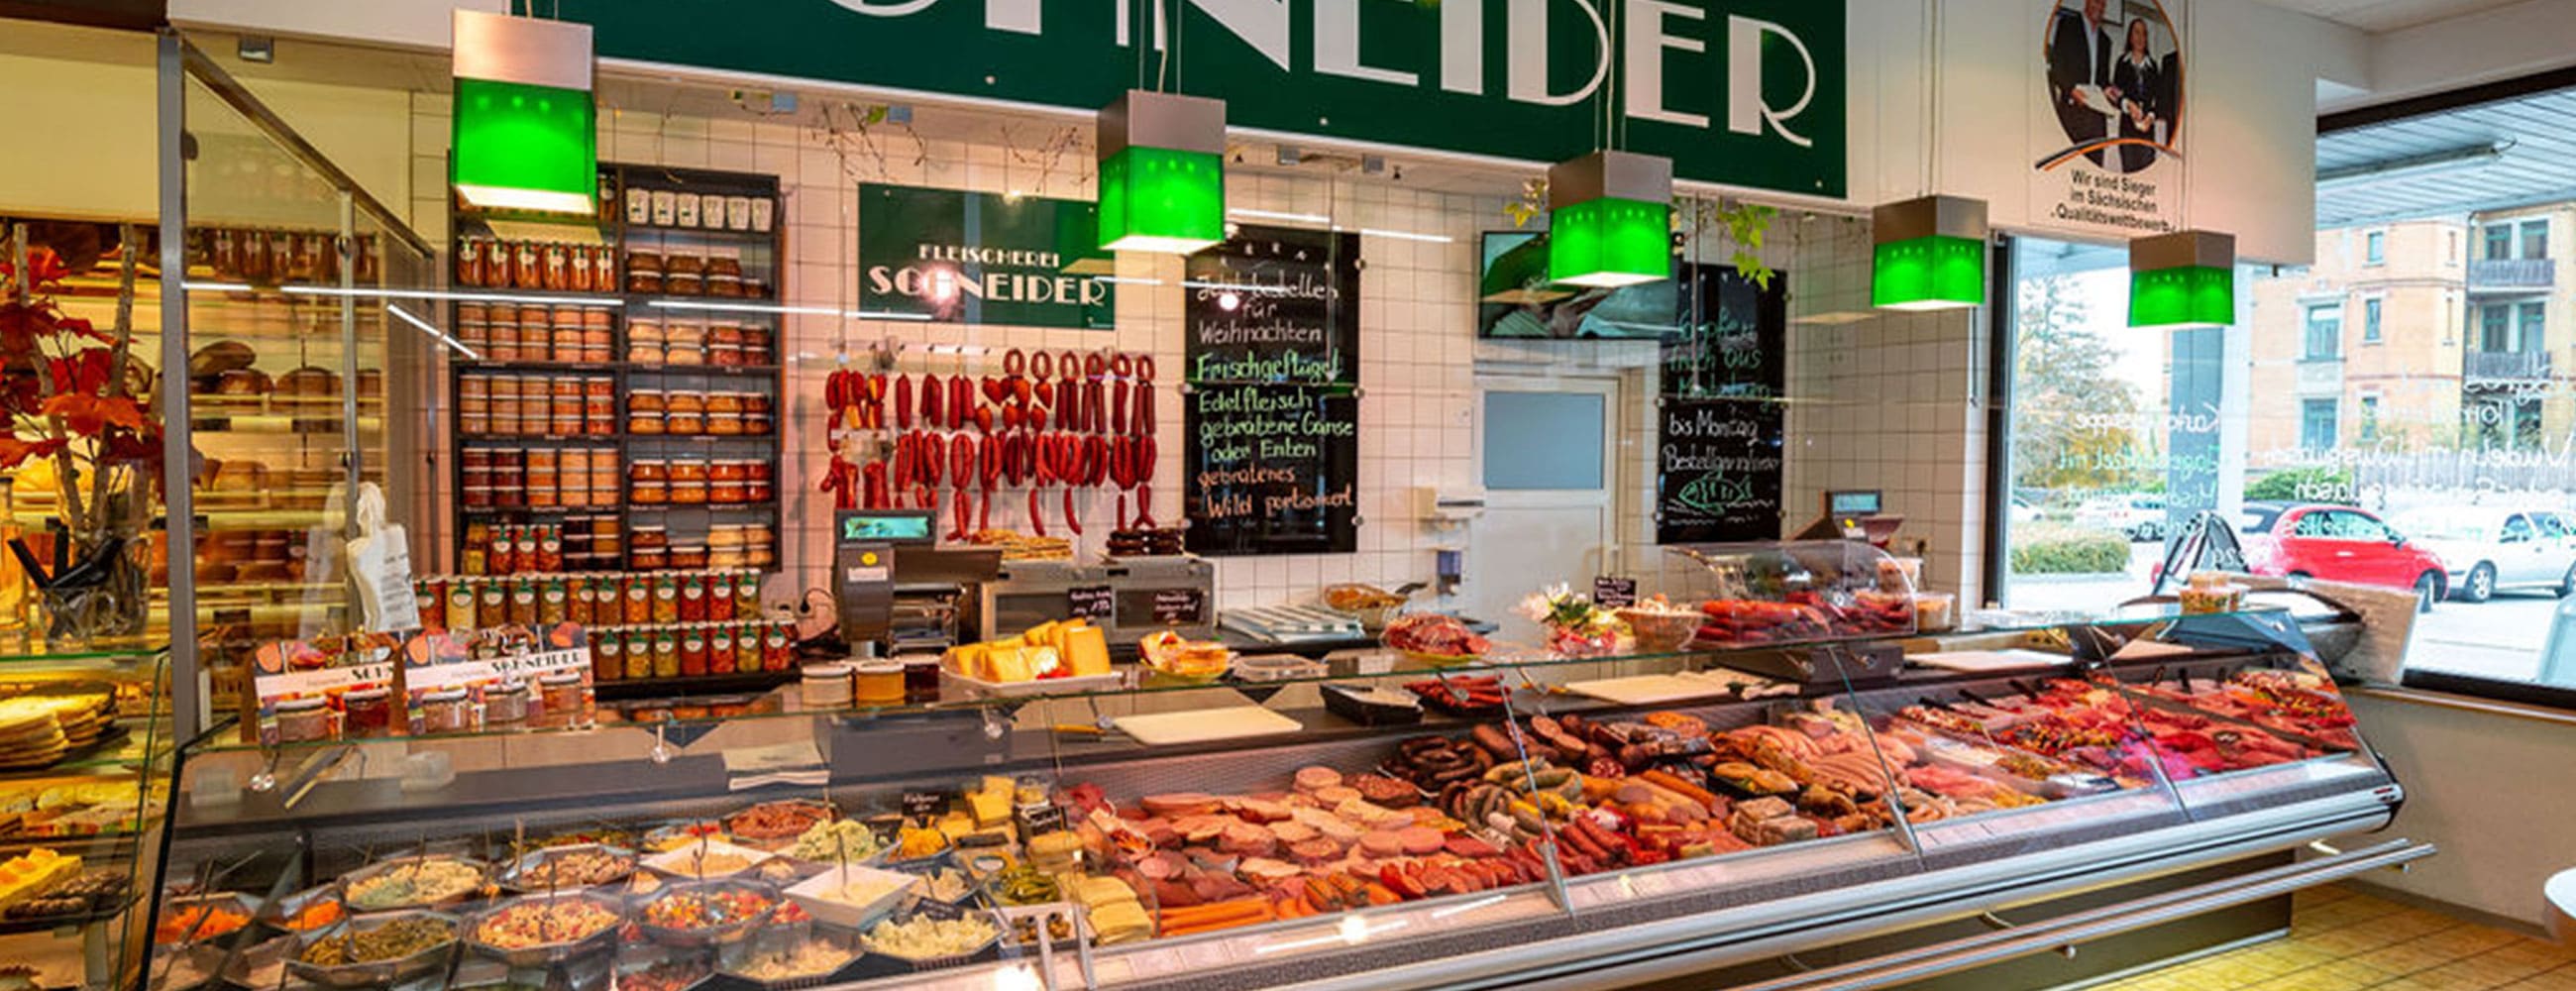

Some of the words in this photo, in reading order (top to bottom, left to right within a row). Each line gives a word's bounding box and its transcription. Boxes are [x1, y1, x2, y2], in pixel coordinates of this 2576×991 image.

[830, 0, 1816, 147] NEIDER
[2072, 168, 2092, 185] Wir
[2094, 175, 2118, 190] sind
[2121, 176, 2156, 198] Sieger
[918, 244, 1060, 268] FLEISCHEREI
[868, 265, 1106, 306] SCNEIDER
[1199, 317, 1322, 345] Weihnachten
[1196, 347, 1342, 385] Frischgeflügel
[1198, 385, 1314, 413] Edelfleisch
[1259, 436, 1317, 459] Enten
[1197, 462, 1296, 493] gebratenes
[1206, 494, 1253, 518] Wild
